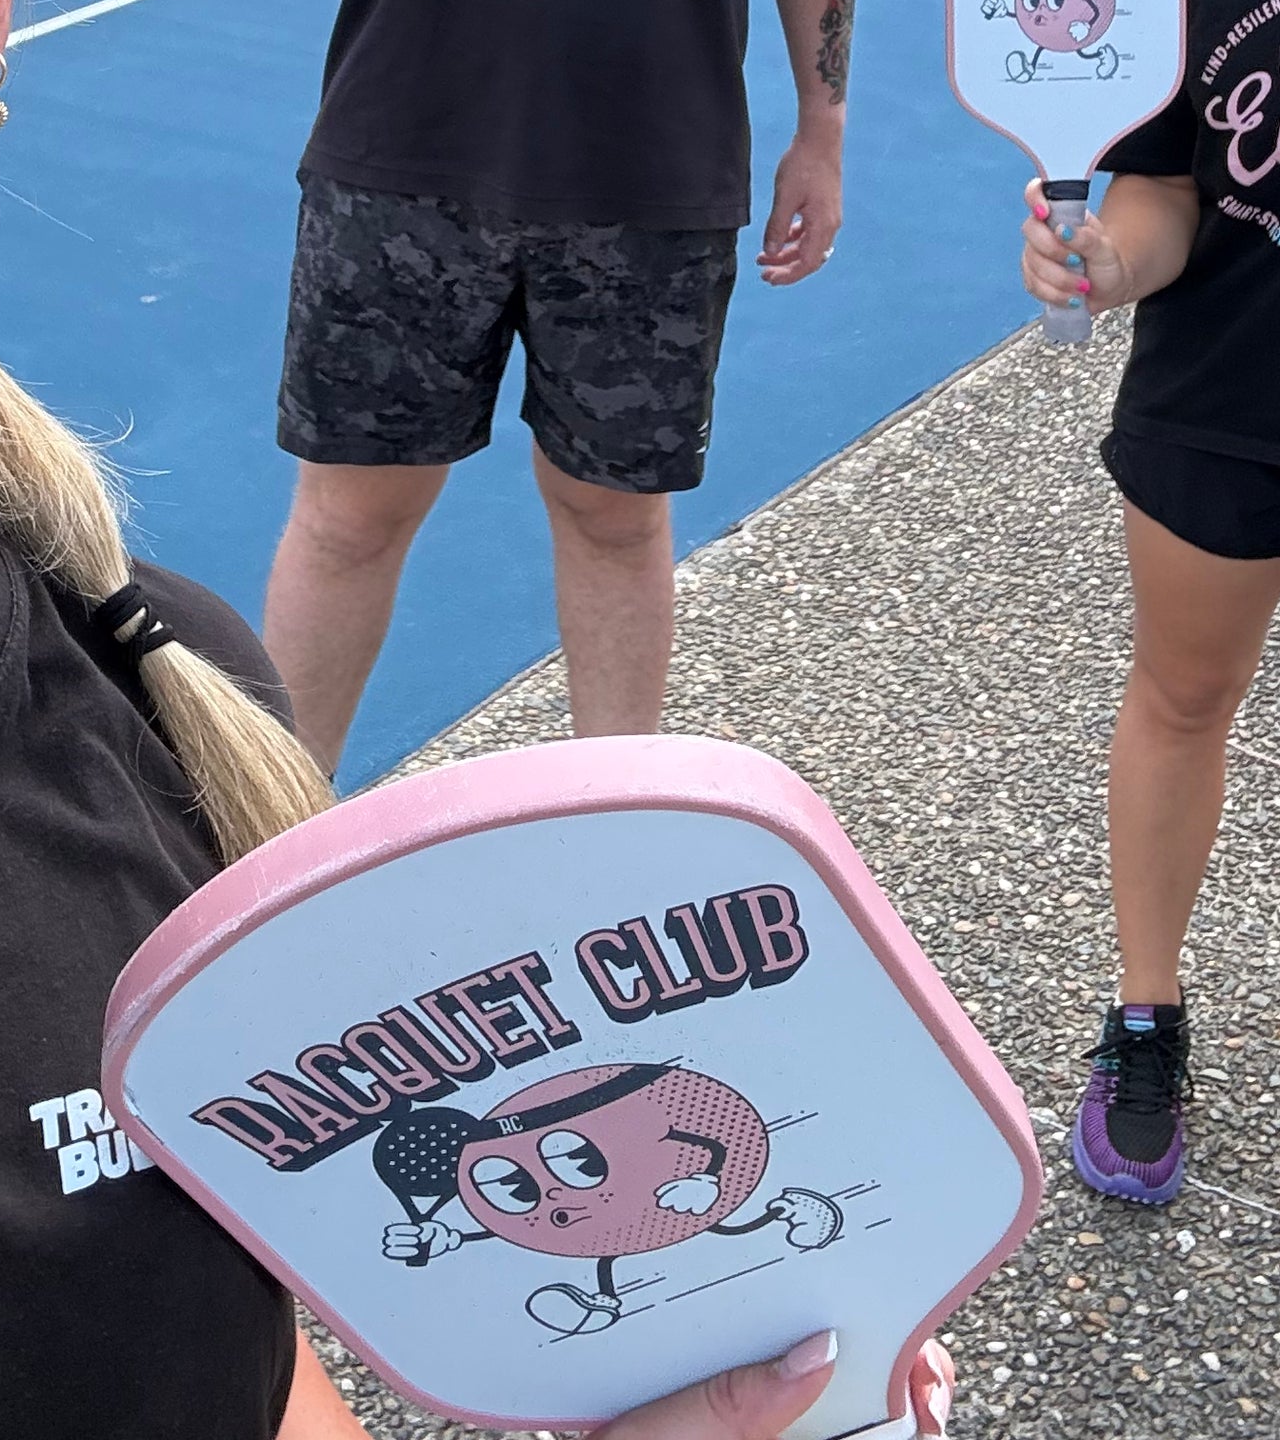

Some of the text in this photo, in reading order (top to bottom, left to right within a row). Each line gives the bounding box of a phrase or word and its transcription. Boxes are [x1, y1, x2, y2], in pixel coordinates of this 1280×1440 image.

[189, 883, 810, 1172] RACQUET CLUB
[496, 1115, 524, 1135] RC
